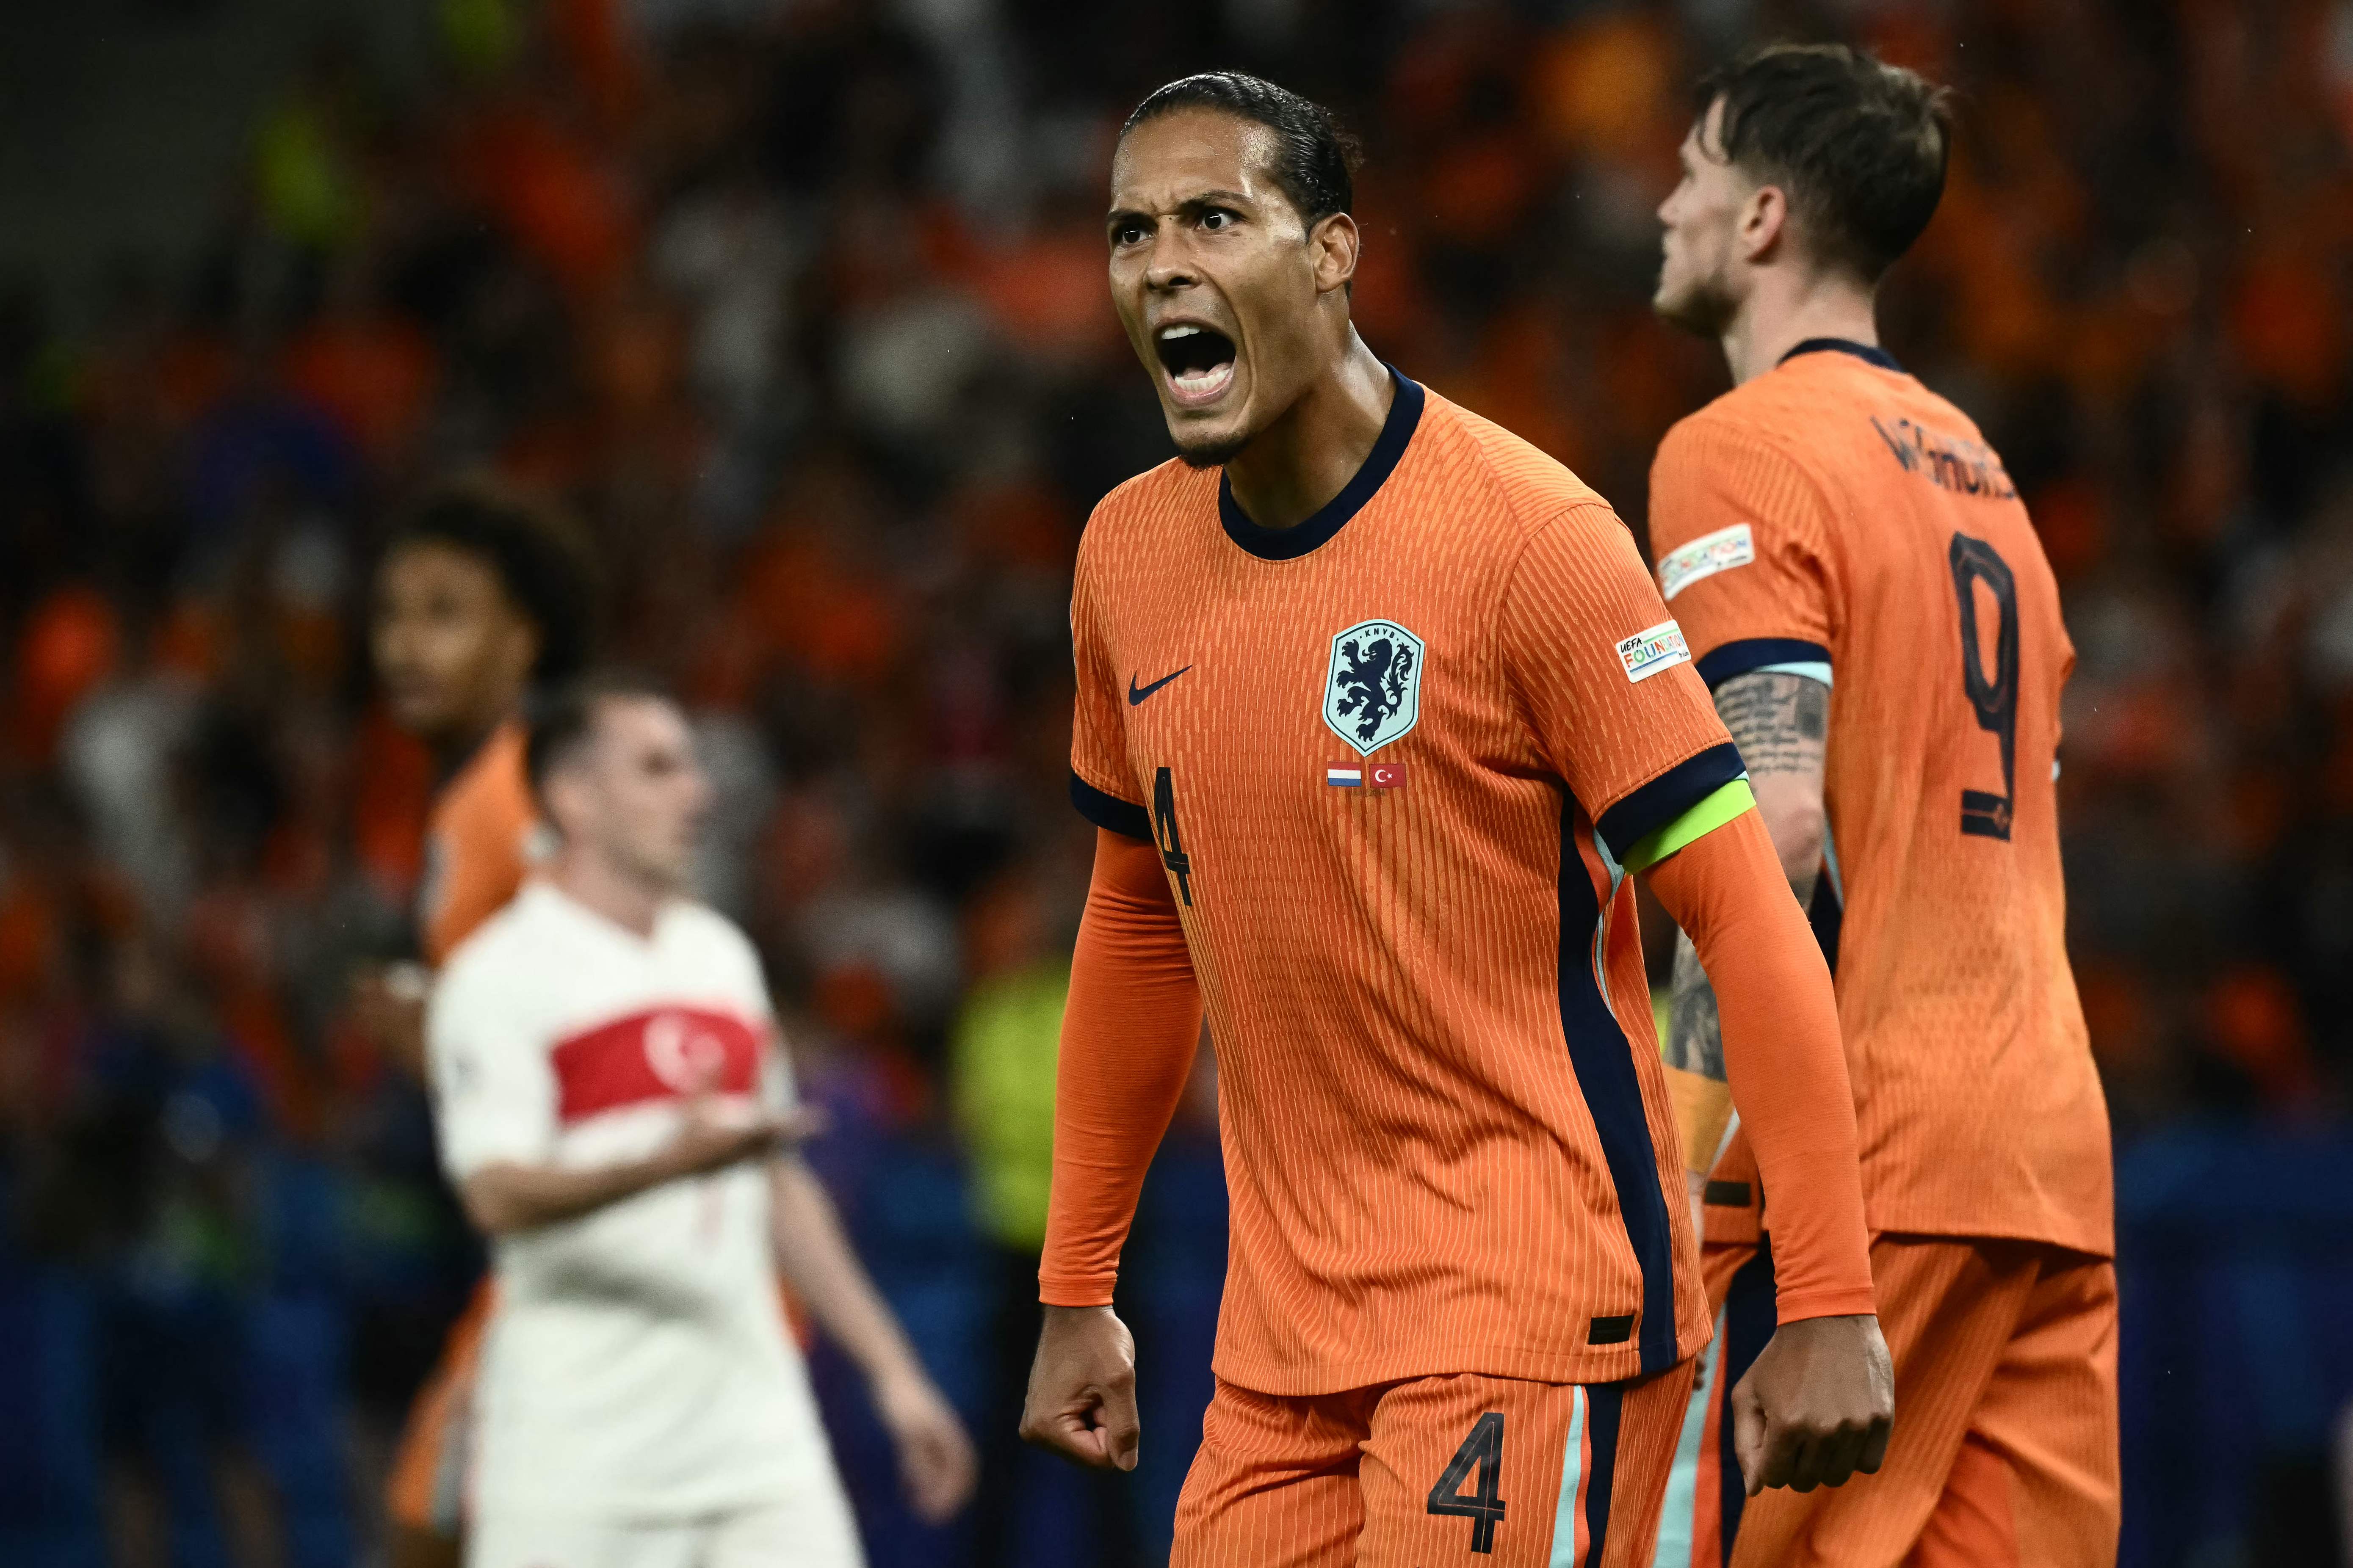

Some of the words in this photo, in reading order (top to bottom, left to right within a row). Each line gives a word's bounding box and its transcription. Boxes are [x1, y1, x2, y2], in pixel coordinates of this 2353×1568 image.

[1365, 627, 1395, 639] KNVB
[1620, 637, 1642, 653] UEFA
[1623, 632, 1686, 668] FOUNDATION
[1949, 531, 2019, 842] 9
[1154, 767, 1192, 907] 4
[1427, 1412, 1506, 1554] 4
